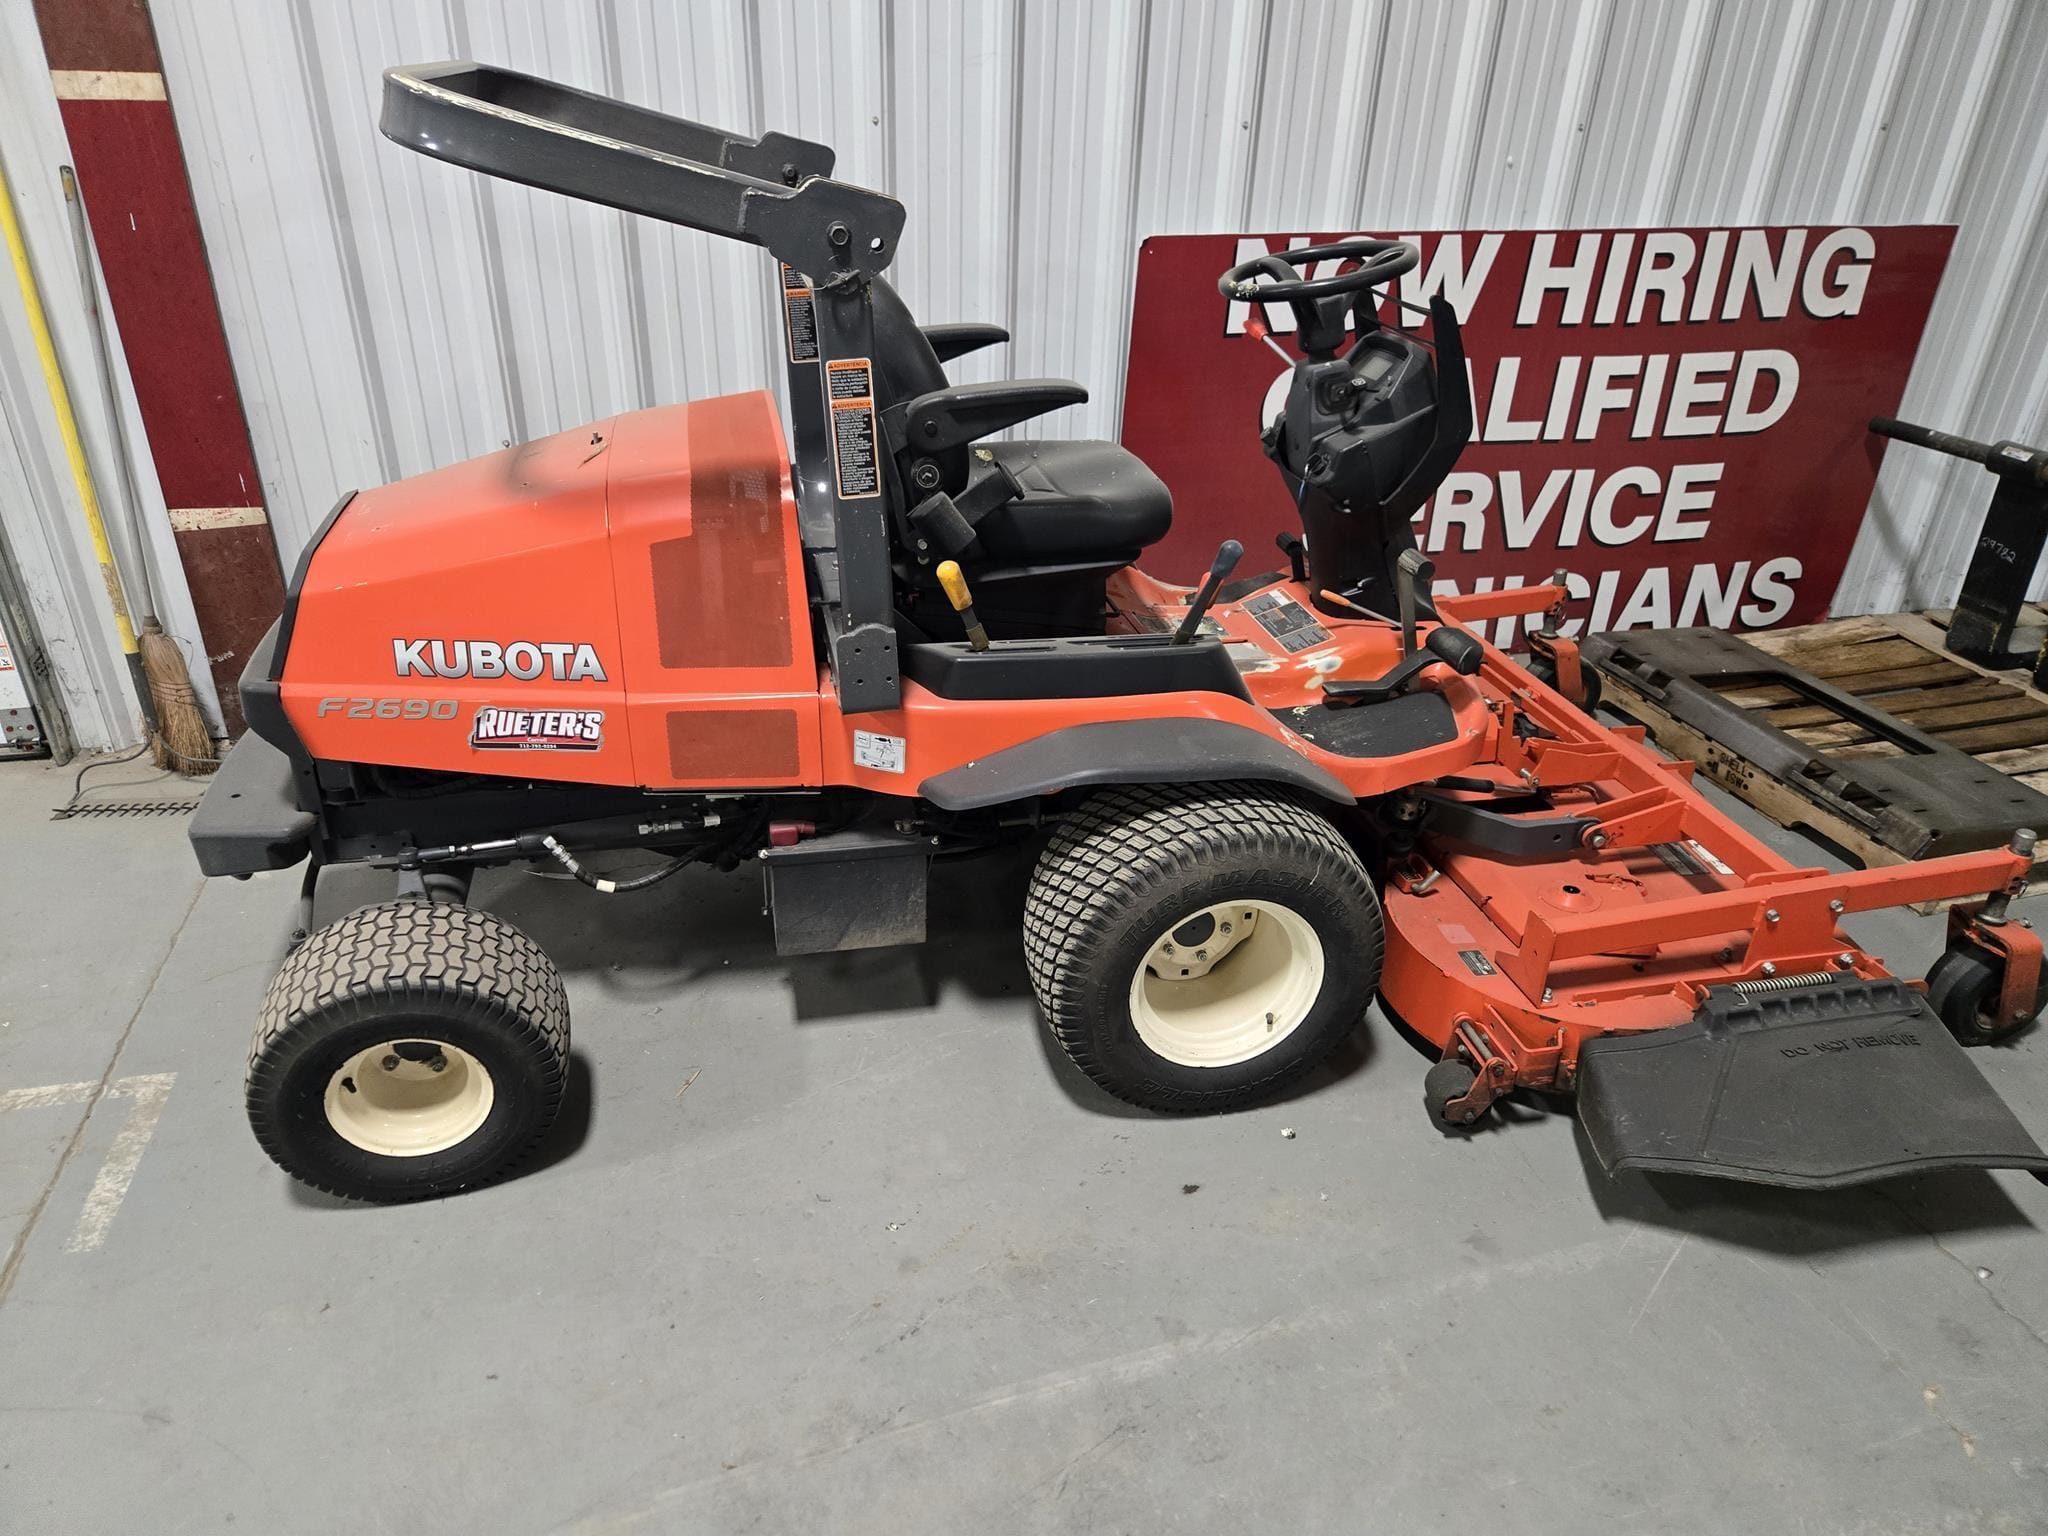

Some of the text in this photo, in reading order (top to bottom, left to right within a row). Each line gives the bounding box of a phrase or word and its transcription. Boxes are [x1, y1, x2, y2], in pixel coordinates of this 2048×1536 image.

[1515, 227, 1876, 326] HIRING
[1261, 349, 1800, 442] LIFIED
[1302, 462, 1725, 552] RVICE
[1430, 556, 1803, 650] ICIANS
[392, 638, 608, 682] KUBOTA
[318, 697, 459, 720] F2690
[478, 708, 602, 741] RUETER'S
[1719, 752, 1747, 778] SHELL
[1118, 869, 1351, 948] TURF MASTER
[1780, 1032, 1921, 1058] DO NOT REMOVE
